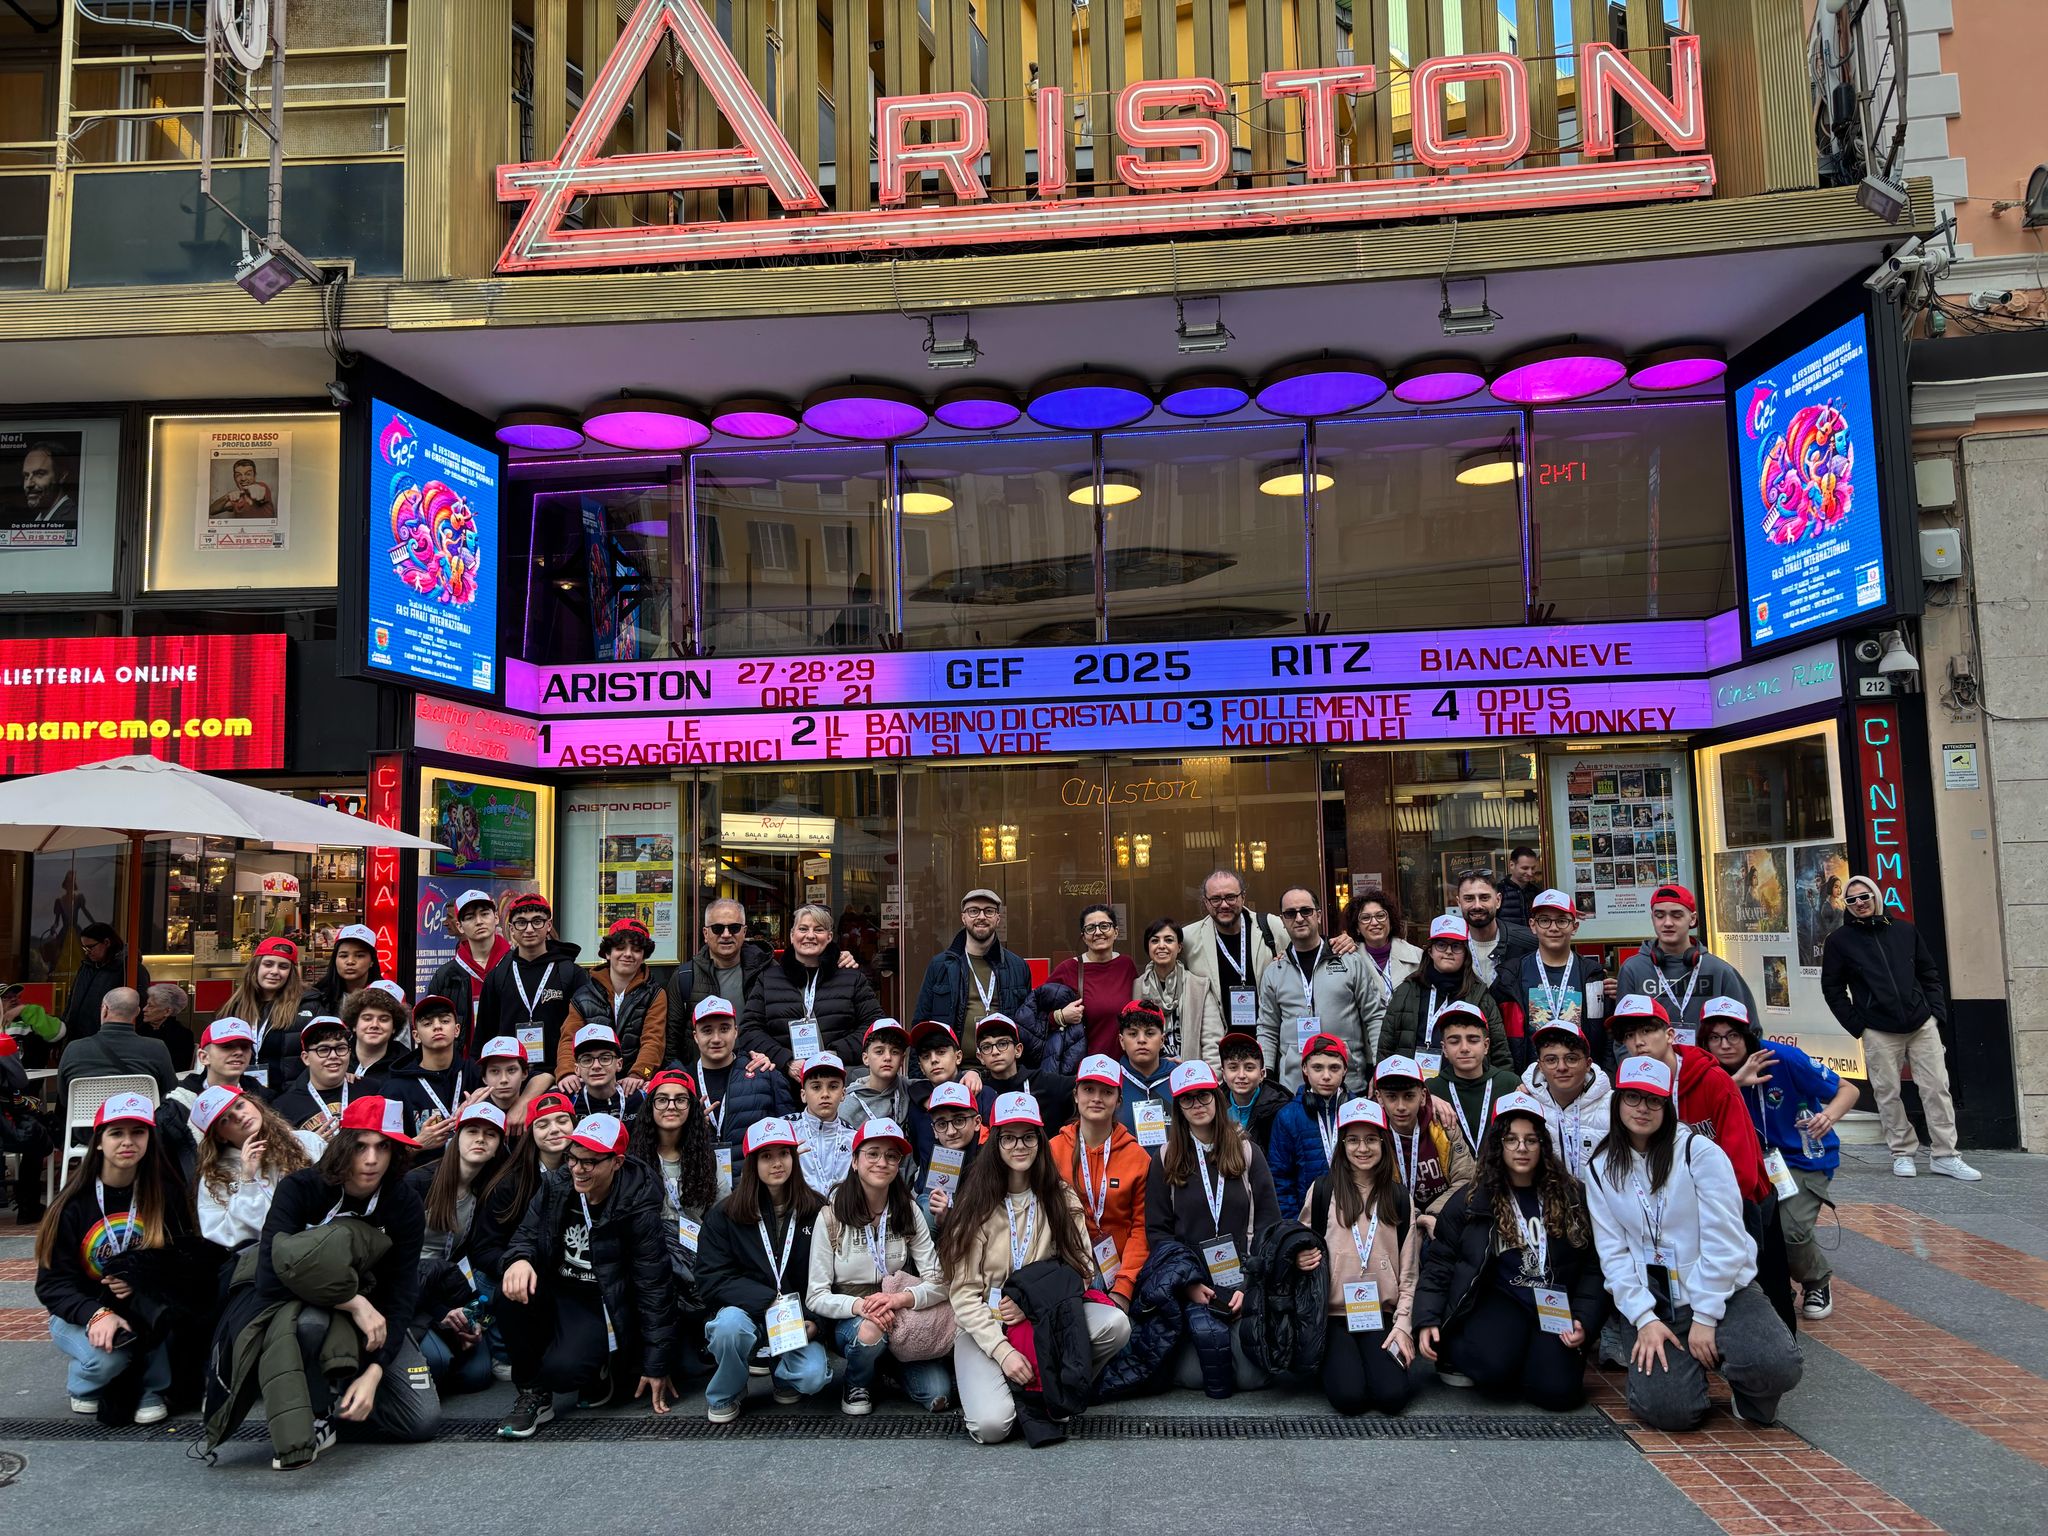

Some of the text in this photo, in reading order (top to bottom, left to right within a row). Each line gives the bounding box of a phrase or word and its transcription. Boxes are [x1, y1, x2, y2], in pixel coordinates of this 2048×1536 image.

[494, 0, 1716, 272] ARISTON
[212, 432, 279, 441] FEDERICO BASSO
[945, 650, 1192, 690] GEF 2025
[1271, 641, 1372, 678] RITZ
[1420, 642, 1633, 672] BIANCANEVE
[0, 665, 197, 686] LIETTERIA ONLINE
[542, 669, 712, 704] ARISTON
[1866, 681, 1885, 692] 212
[761, 684, 873, 710] ORE 21
[1221, 693, 1413, 722] FOLLEMENTE
[1431, 689, 1460, 722] 4
[1476, 686, 1571, 712] OPUS
[0, 718, 253, 741] nsanremo.com
[825, 701, 1183, 738] IL BAMBINO DI CRISTALLO
[1186, 700, 1215, 731] 3
[1479, 706, 1677, 735] THE MONKEY
[538, 724, 551, 754] 1
[667, 720, 701, 743] LE
[790, 715, 817, 746] 2
[825, 731, 1053, 759] E POI SI VEDE
[1221, 716, 1407, 747] MUORI DI LEI
[558, 738, 782, 768] ASSAGGIATRICI
[567, 801, 672, 814] ARISTON ROOF
[1864, 718, 1905, 913] CINEMA
[761, 817, 787, 833] Roof
[263, 878, 298, 892] POP CORN
[424, 900, 448, 935] Gef
[1802, 968, 1818, 976] ORARIO
[1768, 1035, 1798, 1047] OGGI
[1827, 1057, 1859, 1073] CINEMA
